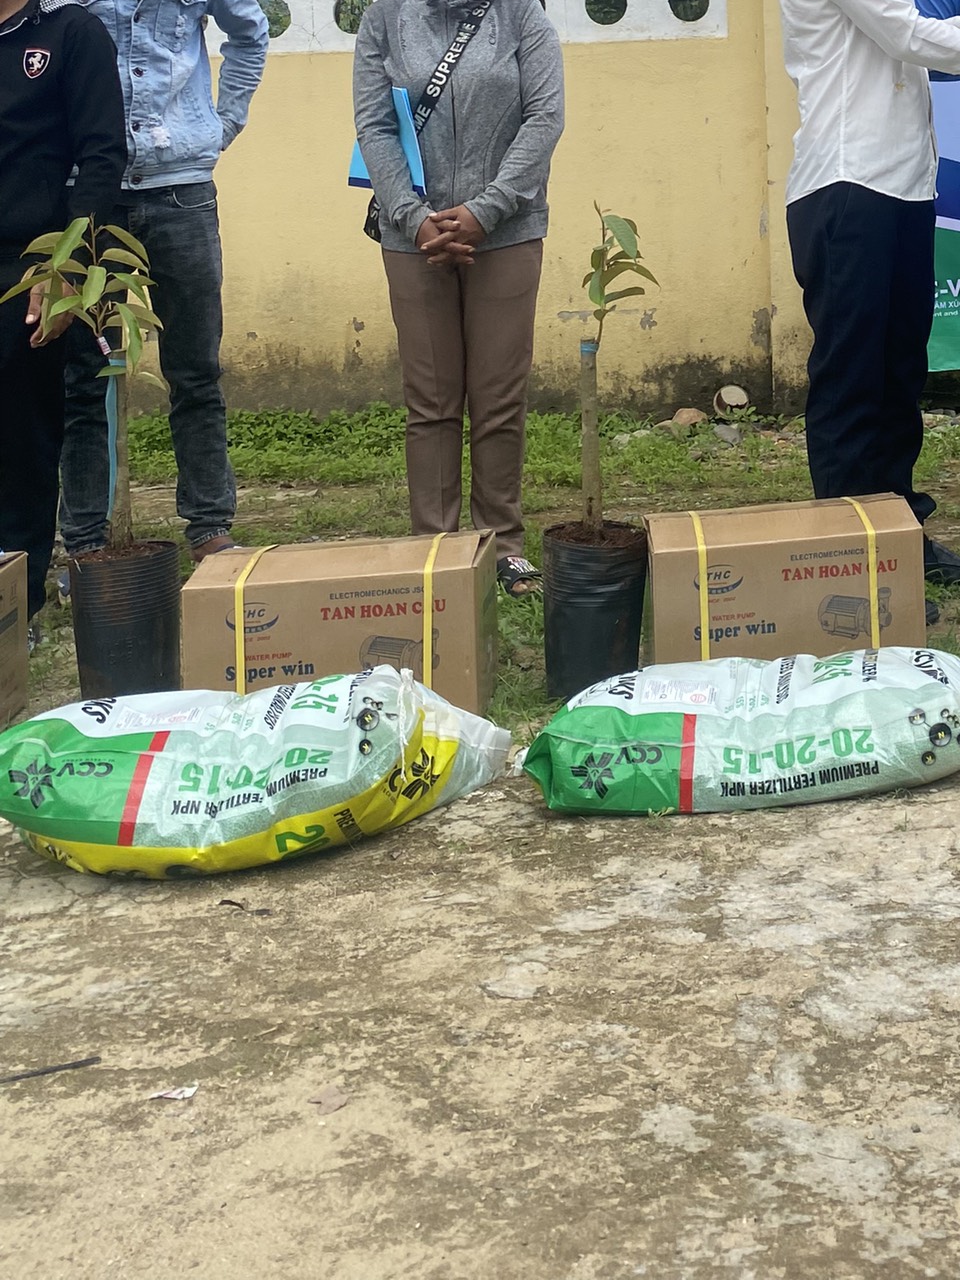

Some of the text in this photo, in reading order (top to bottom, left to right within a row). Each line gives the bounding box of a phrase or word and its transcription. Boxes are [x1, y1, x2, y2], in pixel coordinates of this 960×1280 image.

[426, 22, 476, 98] SUPREME
[790, 548, 865, 561] ELECTROMECHANICS
[707, 570, 731, 580] THC
[781, 566, 814, 581] TAN
[818, 563, 862, 578] HOAN
[329, 586, 411, 600] ELECTROMECHANICS
[320, 599, 446, 621] TAN HOAN CU
[712, 612, 756, 622] WATER PUMP
[745, 620, 776, 635] win
[245, 652, 293, 662] WATER PUMP
[225, 660, 315, 683] Sper win
[615, 746, 663, 765] CCV
[723, 725, 875, 775] 20-20-15
[56, 761, 114, 778] CCV
[720, 761, 880, 797] PREMIUM FERTILIZER NPK
[172, 800, 202, 816] NPK
